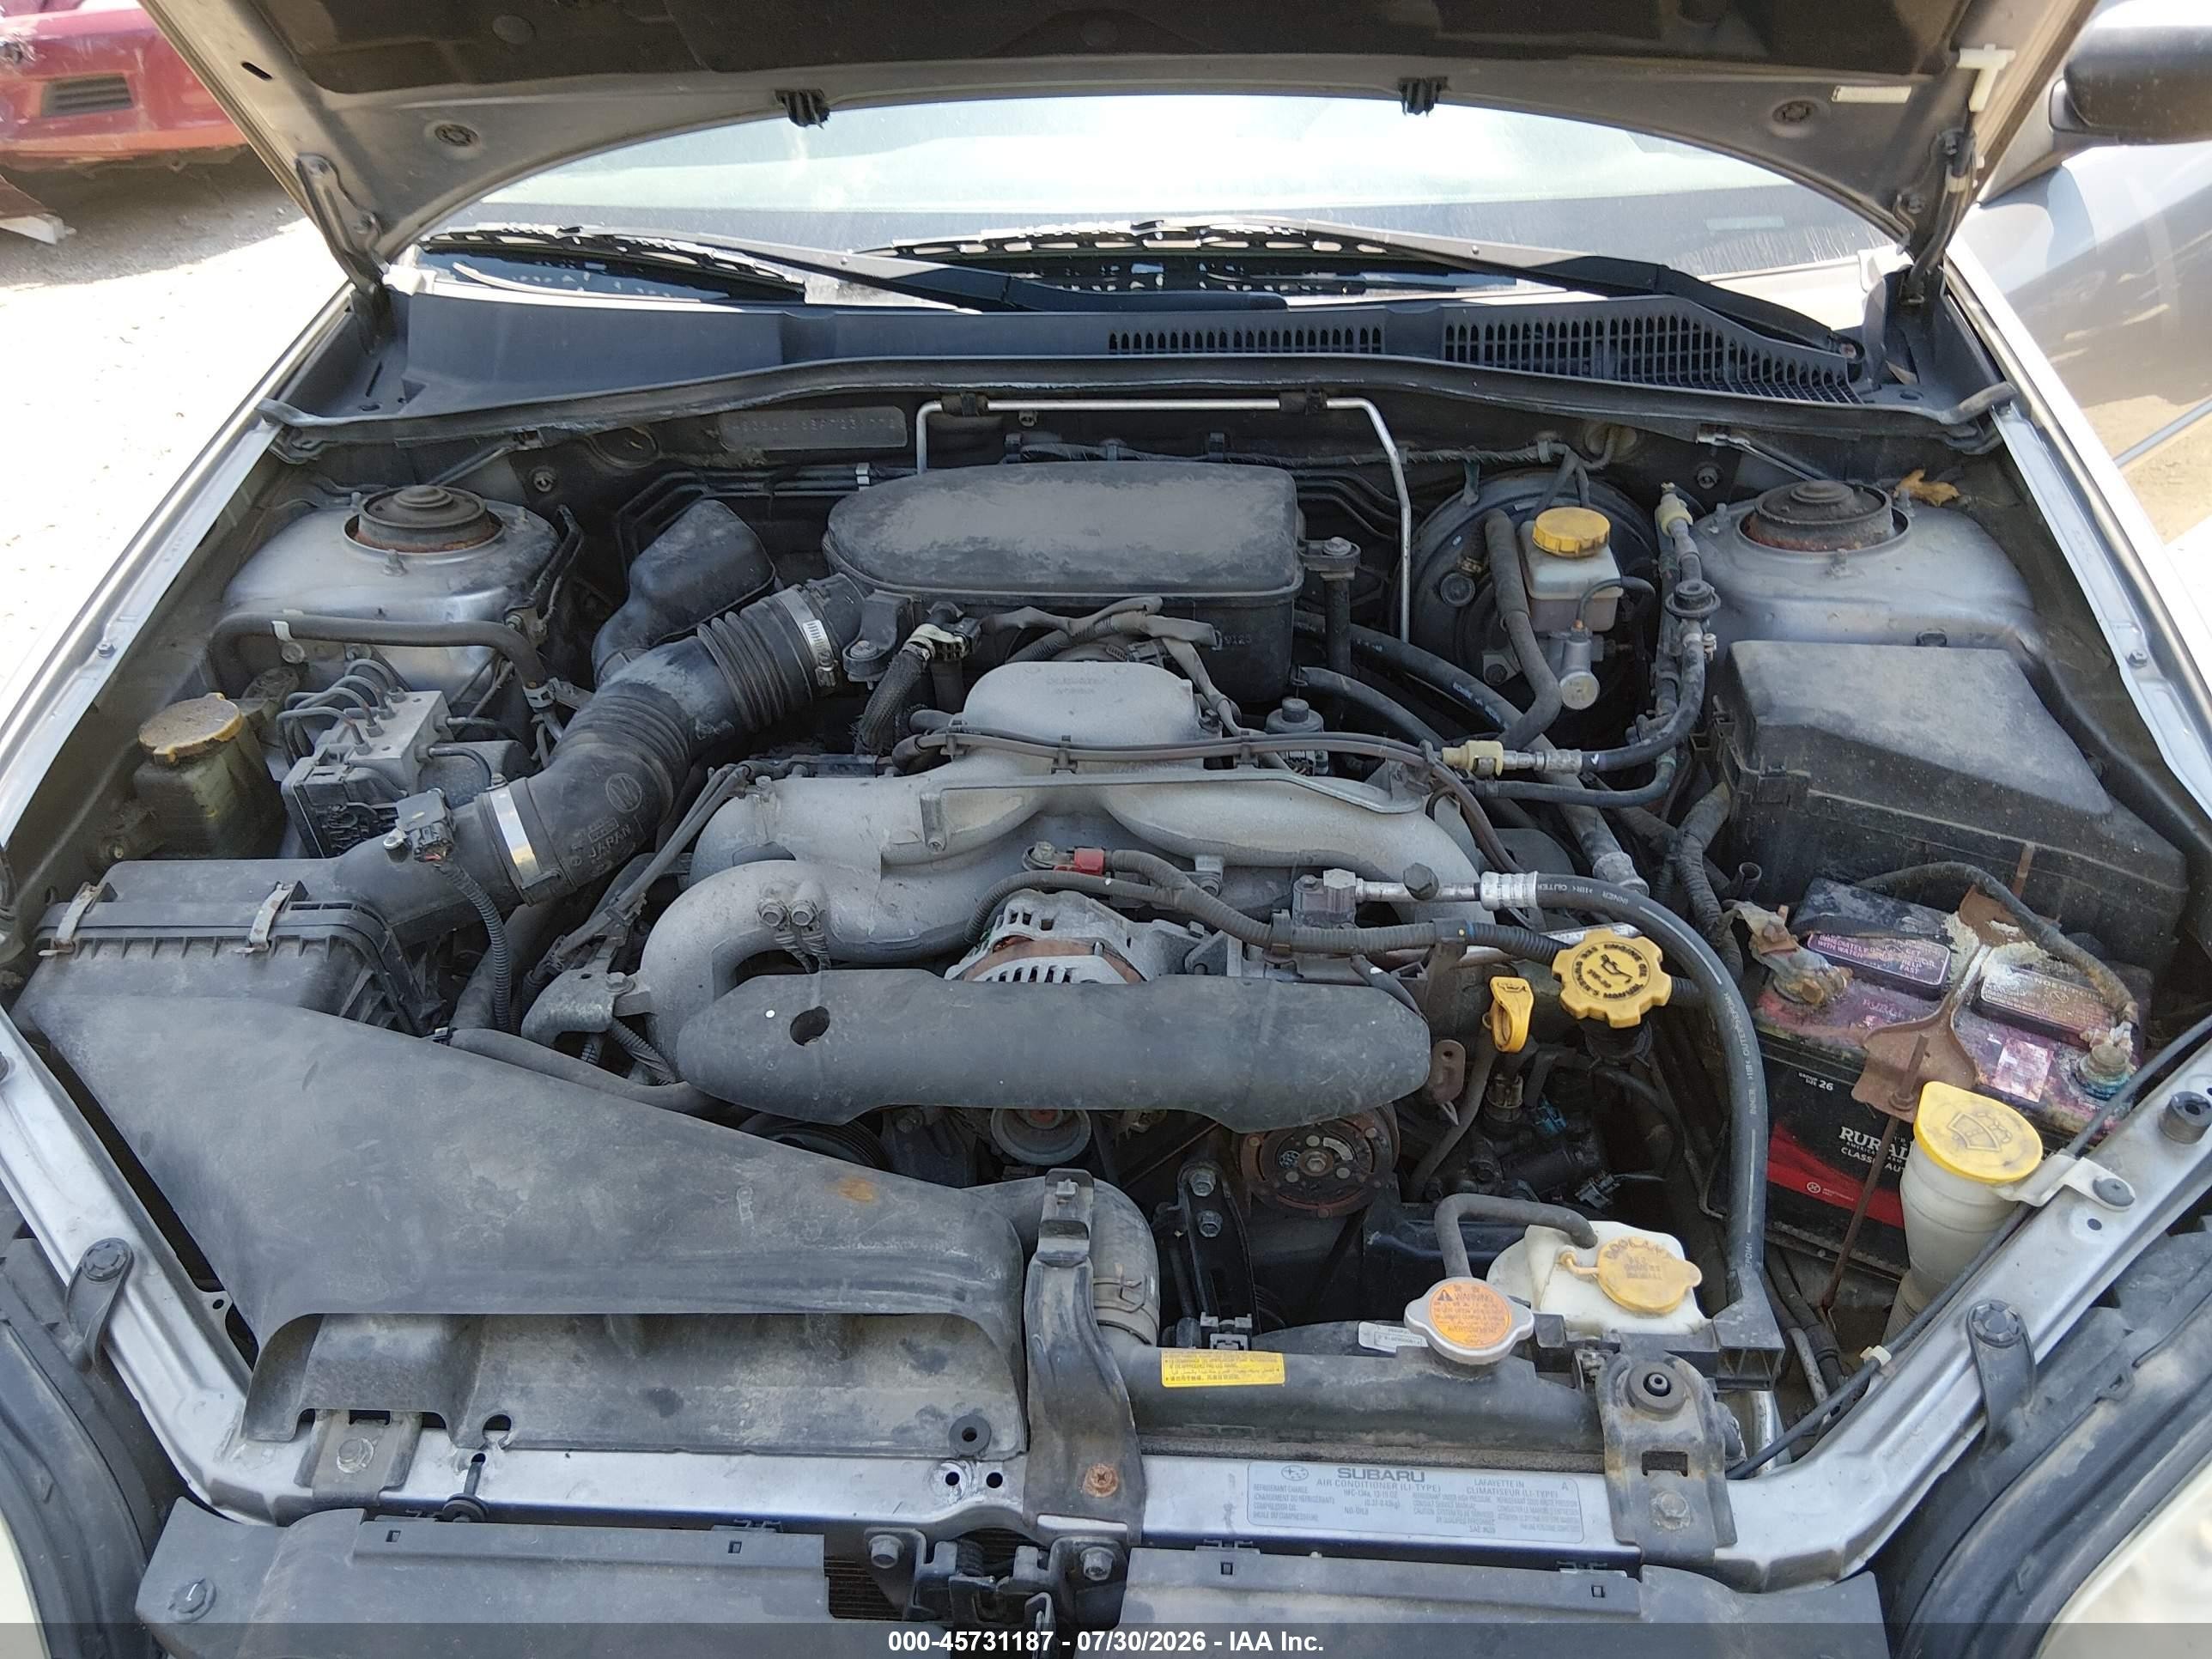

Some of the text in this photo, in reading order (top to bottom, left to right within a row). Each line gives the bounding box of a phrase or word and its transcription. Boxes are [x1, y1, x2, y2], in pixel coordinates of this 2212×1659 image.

[589, 825, 631, 859] JAPAN
[1638, 963, 1648, 978] OIL
[1818, 1080, 1834, 1091] 26
[1337, 1468, 1425, 1482] SUBARU
[1334, 1480, 1398, 1490] CONDITIONER
[1561, 1481, 1569, 1491] A
